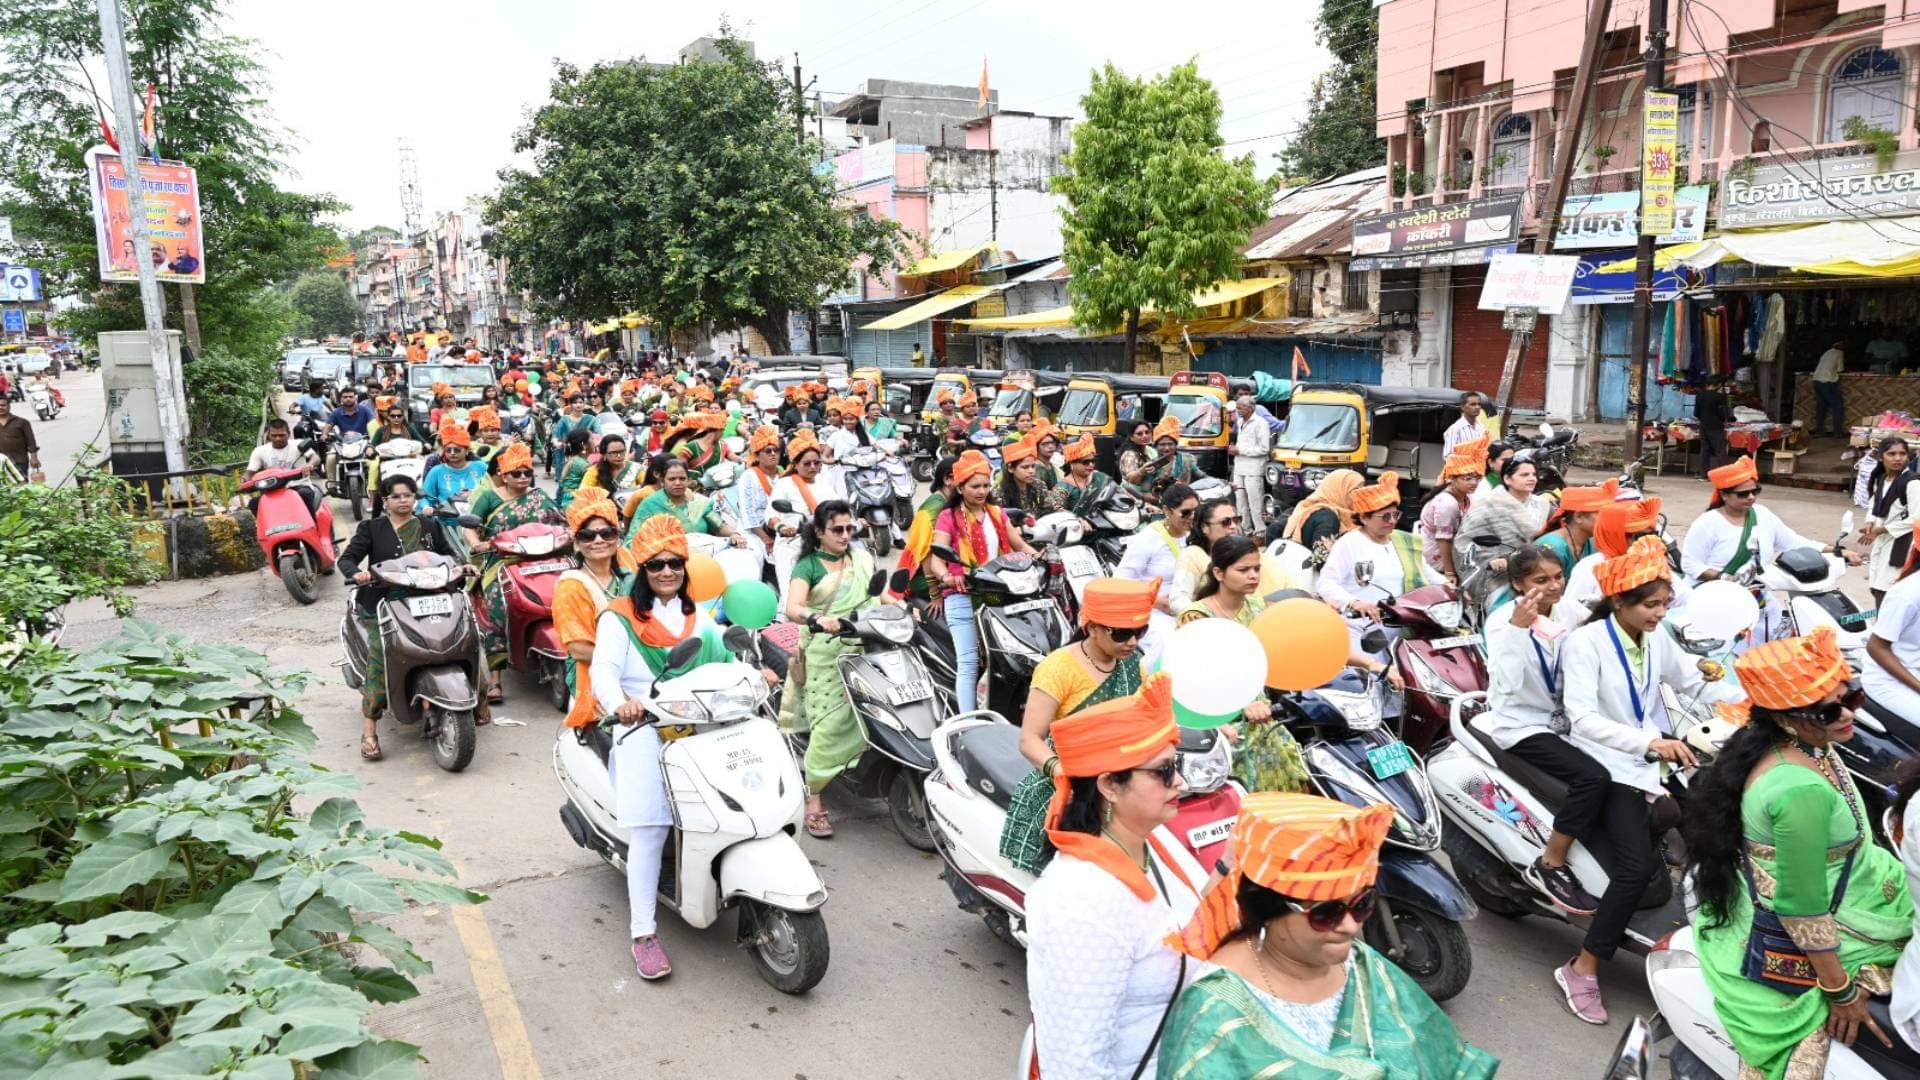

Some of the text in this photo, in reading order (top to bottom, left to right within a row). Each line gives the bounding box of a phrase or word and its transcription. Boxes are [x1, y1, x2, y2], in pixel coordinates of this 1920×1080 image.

[1728, 174, 1820, 209] किशोर
[1398, 208, 1438, 228] स्वदेशी
[1439, 203, 1471, 220] स्टोर्स
